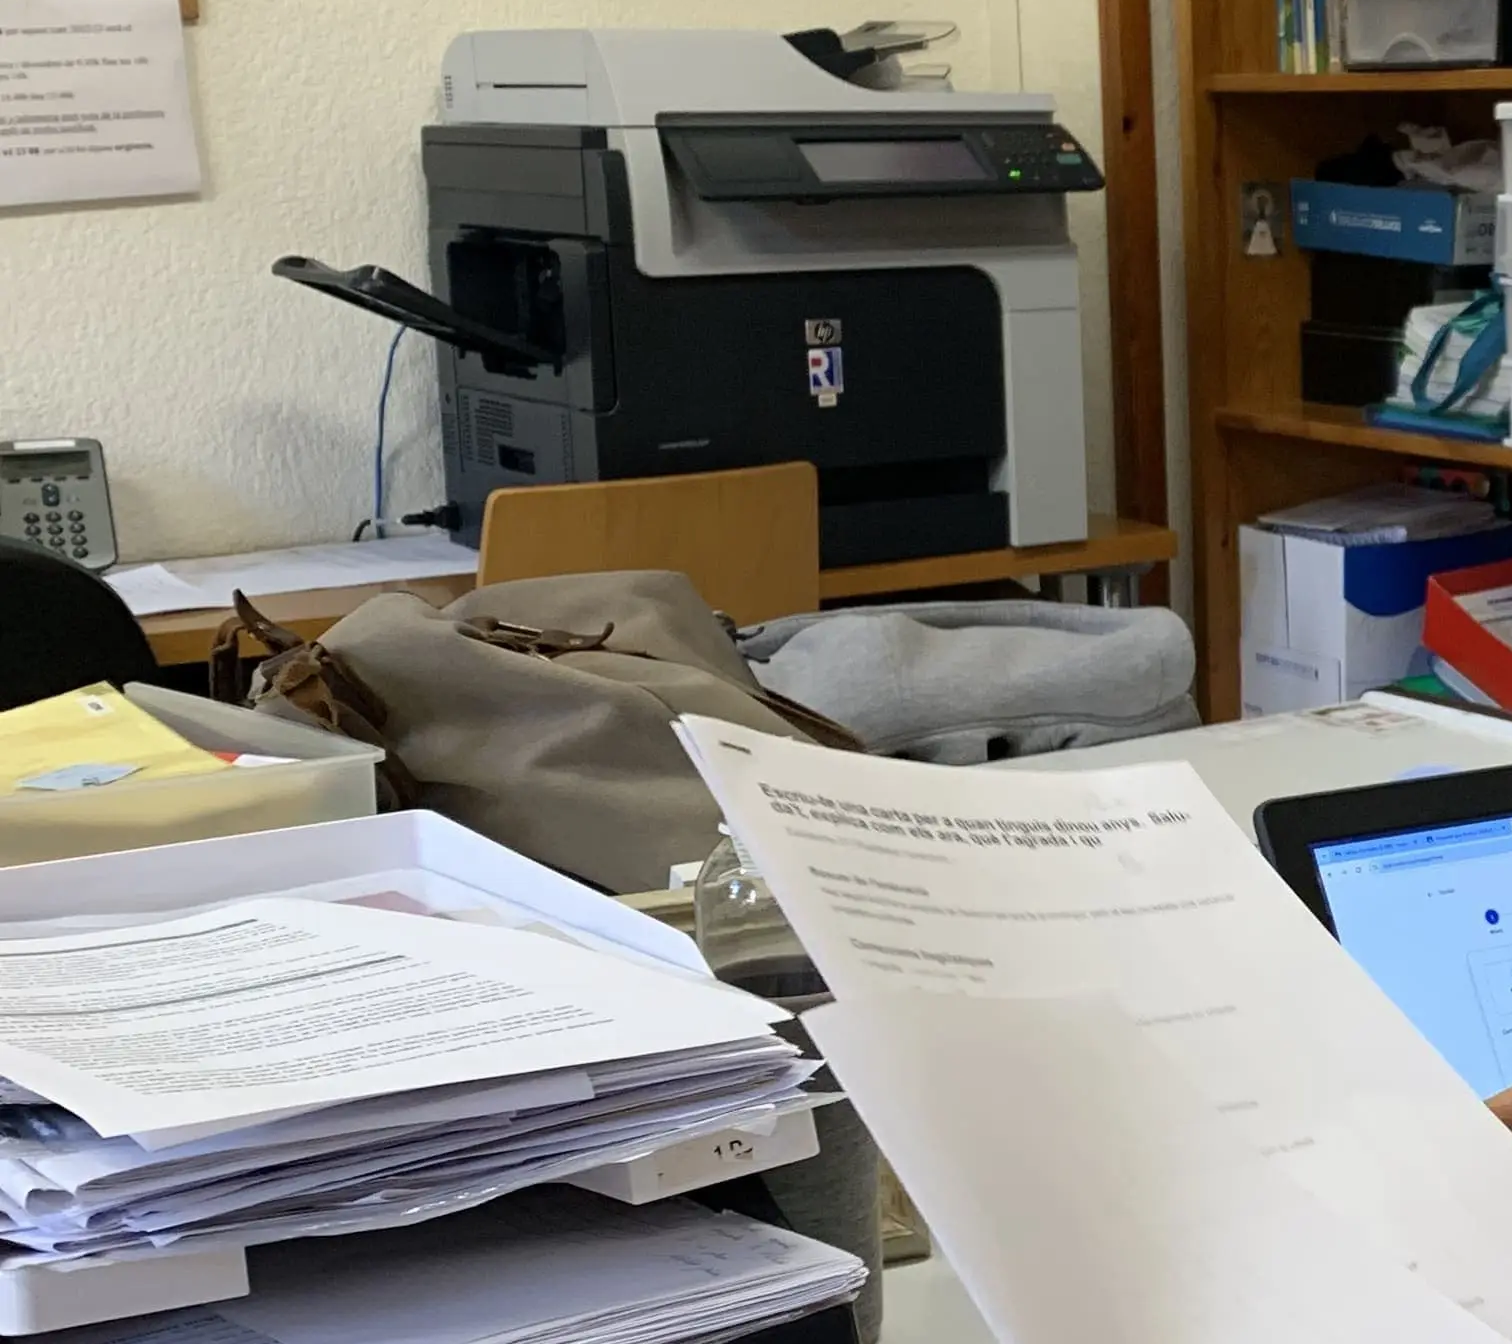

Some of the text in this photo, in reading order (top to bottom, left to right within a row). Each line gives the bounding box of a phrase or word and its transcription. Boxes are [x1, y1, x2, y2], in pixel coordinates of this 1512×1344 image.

[809, 808, 869, 830] explica
[870, 820, 906, 836] com
[869, 807, 912, 824] carta
[912, 813, 939, 829] per
[941, 816, 953, 828] a
[954, 817, 994, 833] quan
